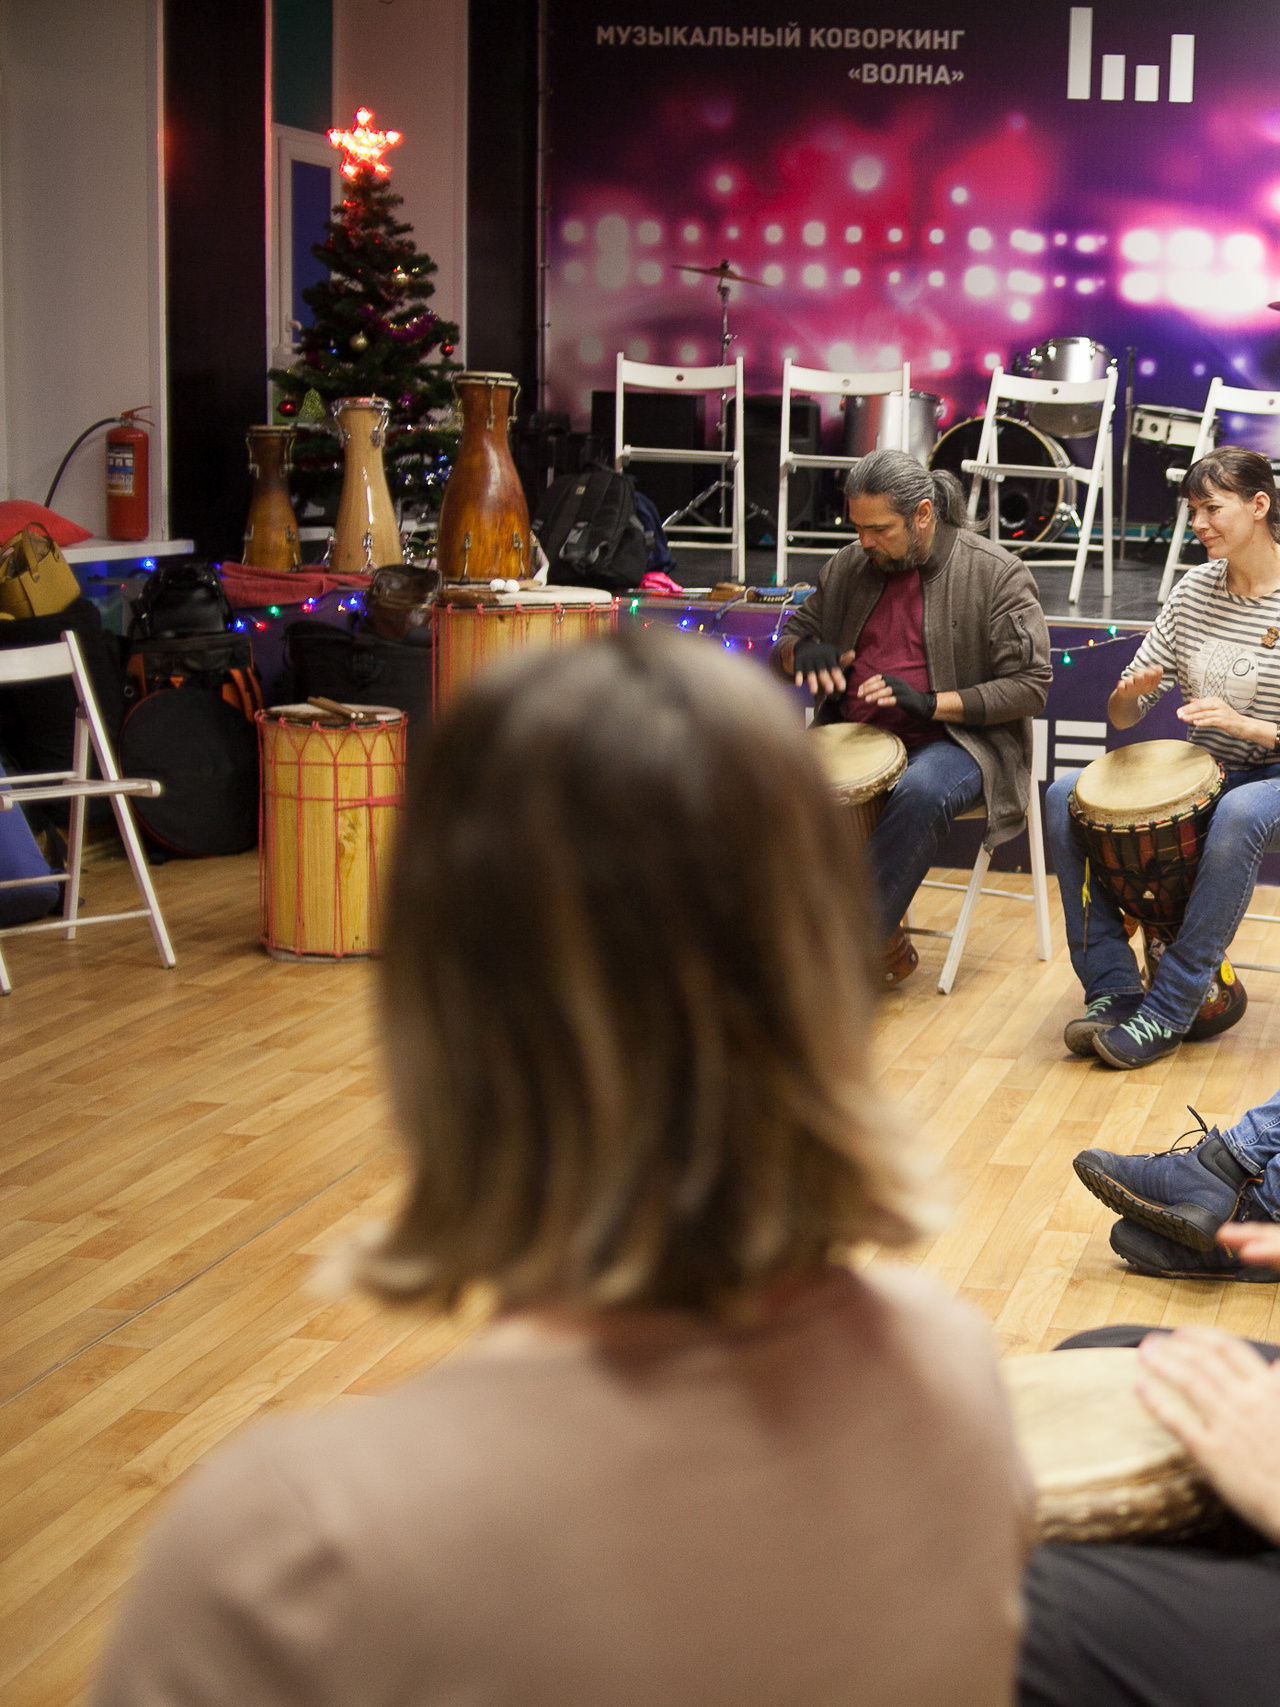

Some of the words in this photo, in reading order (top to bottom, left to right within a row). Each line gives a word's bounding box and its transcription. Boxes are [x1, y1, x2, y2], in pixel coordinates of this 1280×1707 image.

[596, 22, 800, 47] МУЗЫКАЛЬНЫЙ
[809, 28, 965, 50] КОВОРКИНГ
[848, 63, 964, 85] «ВОЛНА»
